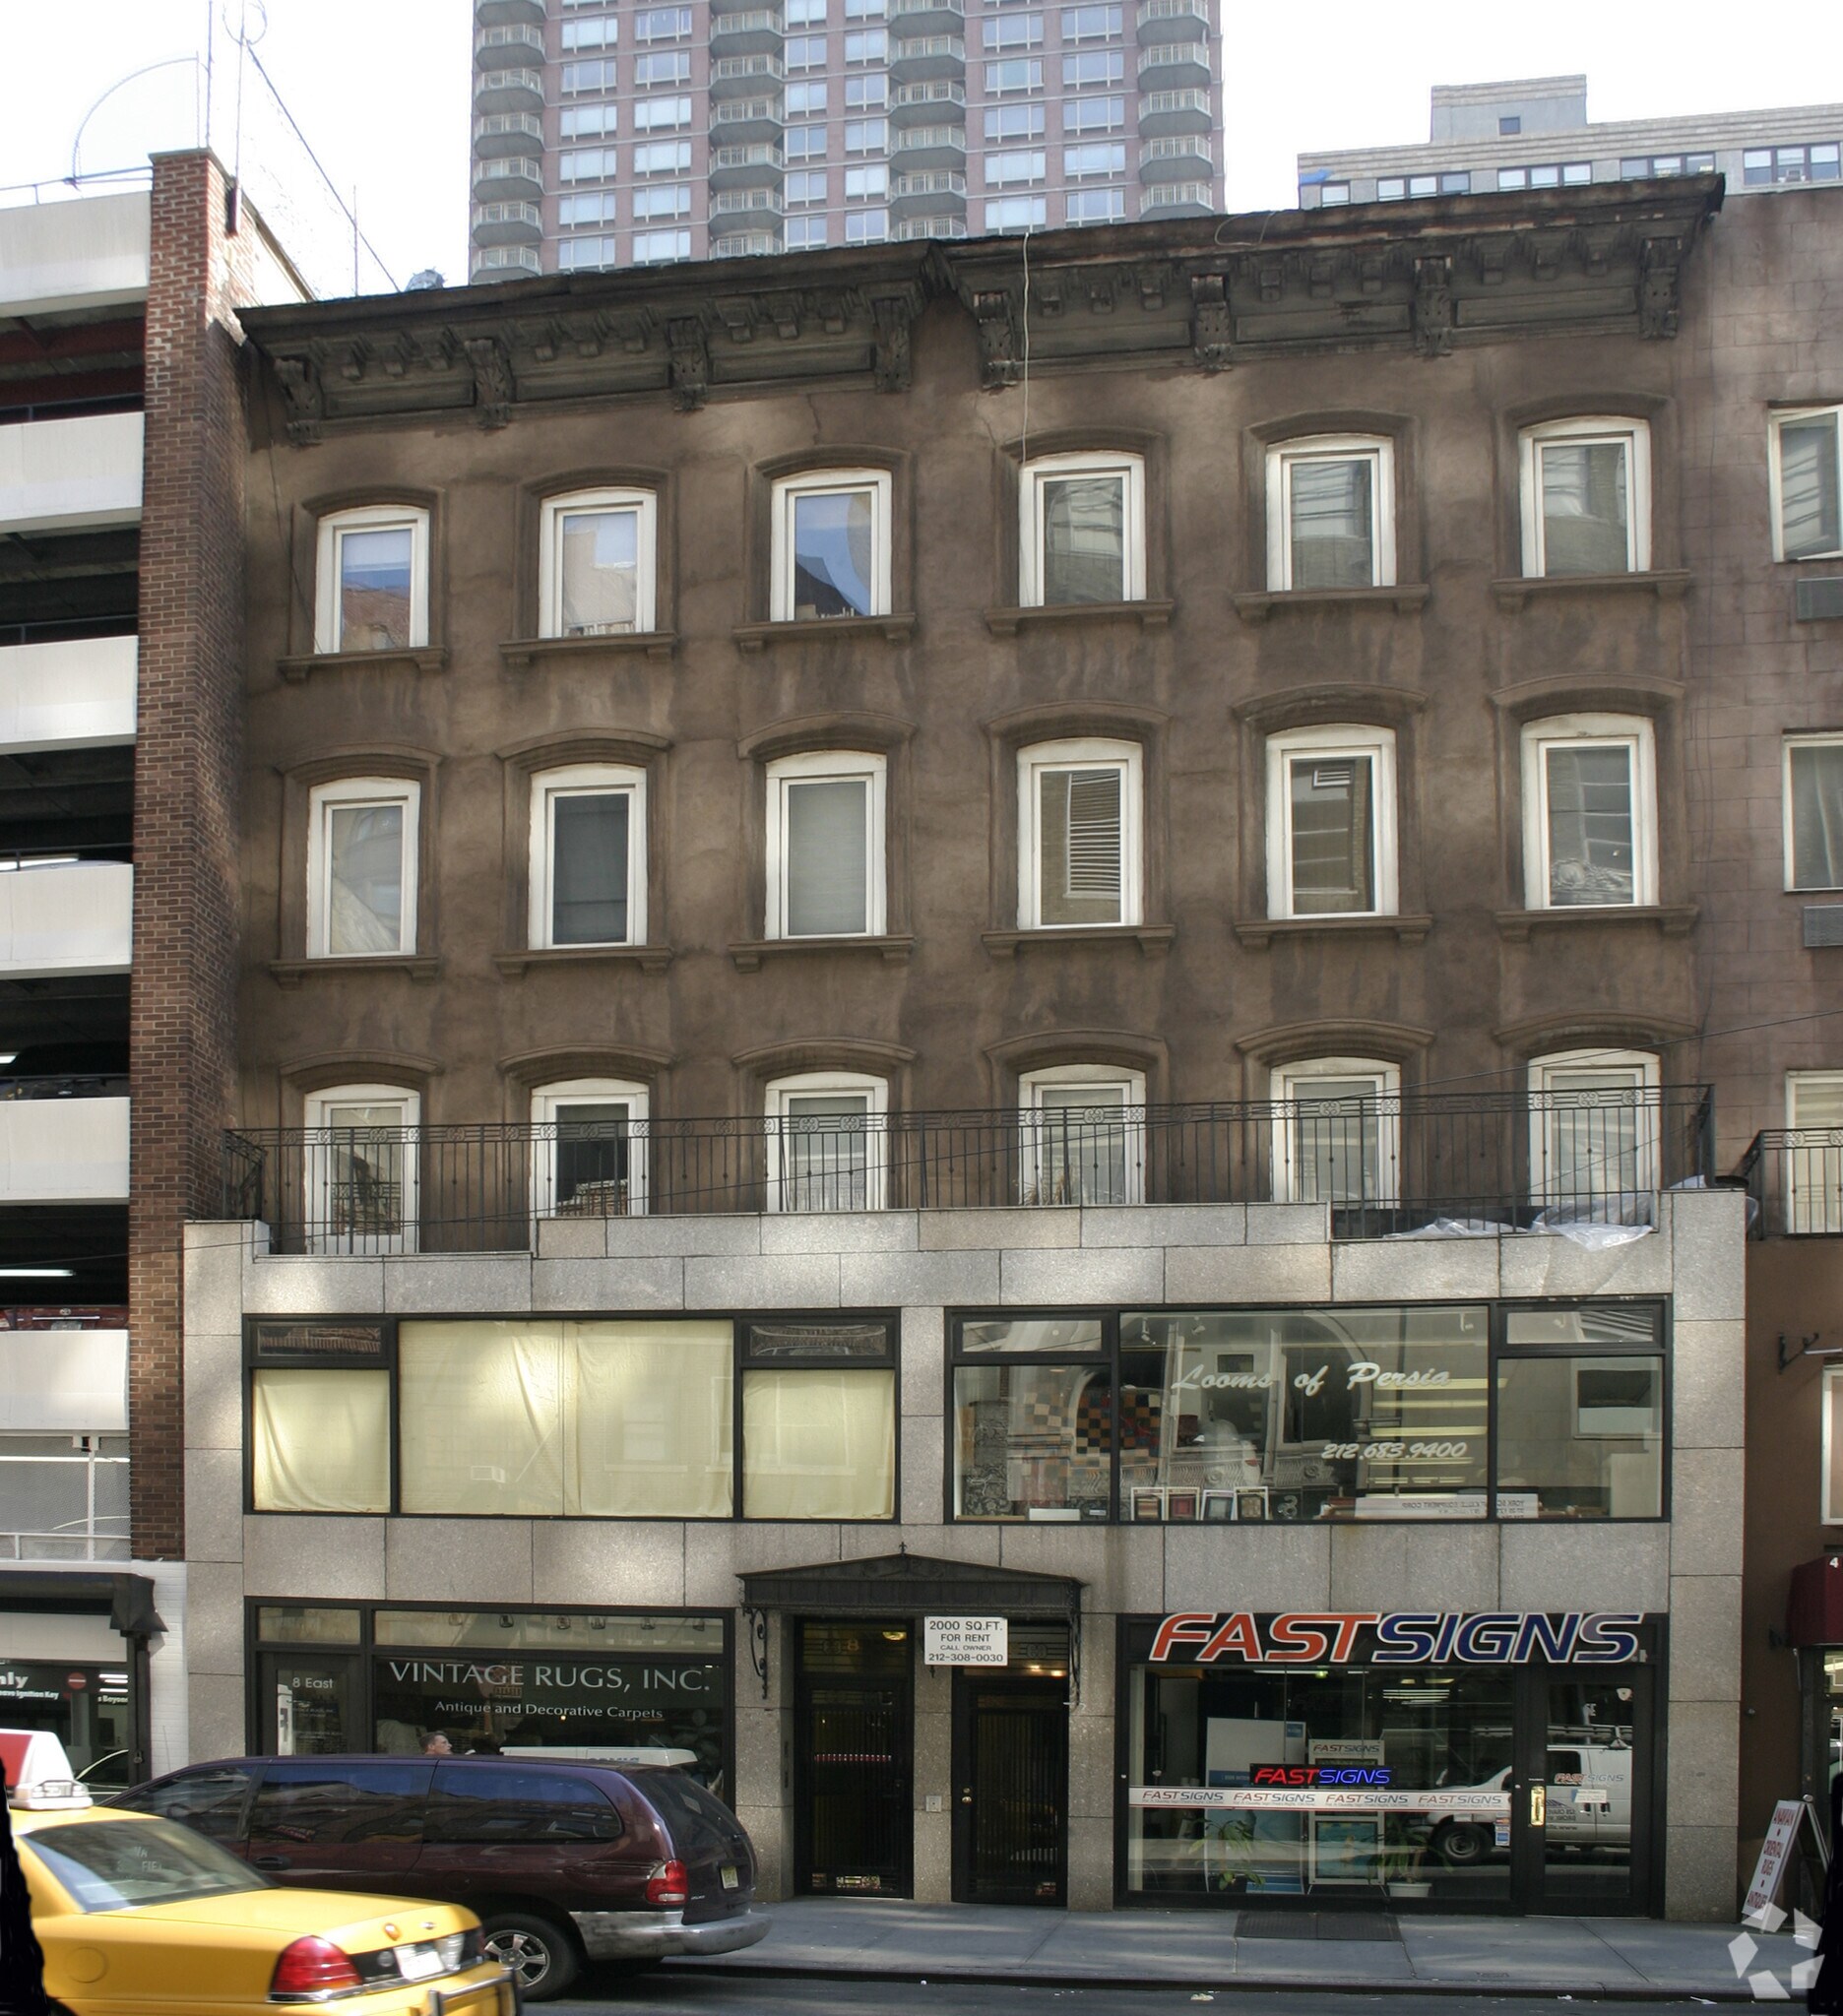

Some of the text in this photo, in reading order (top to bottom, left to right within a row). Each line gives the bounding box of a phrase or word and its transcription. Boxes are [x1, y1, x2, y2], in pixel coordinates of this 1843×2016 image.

[1172, 1361, 1450, 1396] Looms of Persia
[1321, 1441, 1468, 1460] 212.683.9400
[1829, 1556, 1839, 1568] 4
[929, 1620, 1003, 1631] 2000 SQ.FT.
[940, 1633, 991, 1642] FOR RENT
[1148, 1611, 1644, 1665] FASTSIGNS
[928, 1653, 1004, 1662] 212-308-0030
[292, 1677, 334, 1688] 8 East
[388, 1662, 711, 1693] VINTAGE RUGS, INC.
[16, 1690, 44, 1700] Ignition
[44, 1691, 60, 1700] Key
[434, 1700, 664, 1721] Antique and Decorative Carpets
[1313, 1743, 1380, 1754] FASTSIGNS
[1254, 1768, 1392, 1786] FASTSIGNS
[1142, 1790, 1225, 1801] FASTSIGNS
[1233, 1792, 1316, 1803] FASTSIGNS
[1325, 1794, 1409, 1804] FASTSIGNS
[1418, 1795, 1502, 1804] FASTSIGNS
